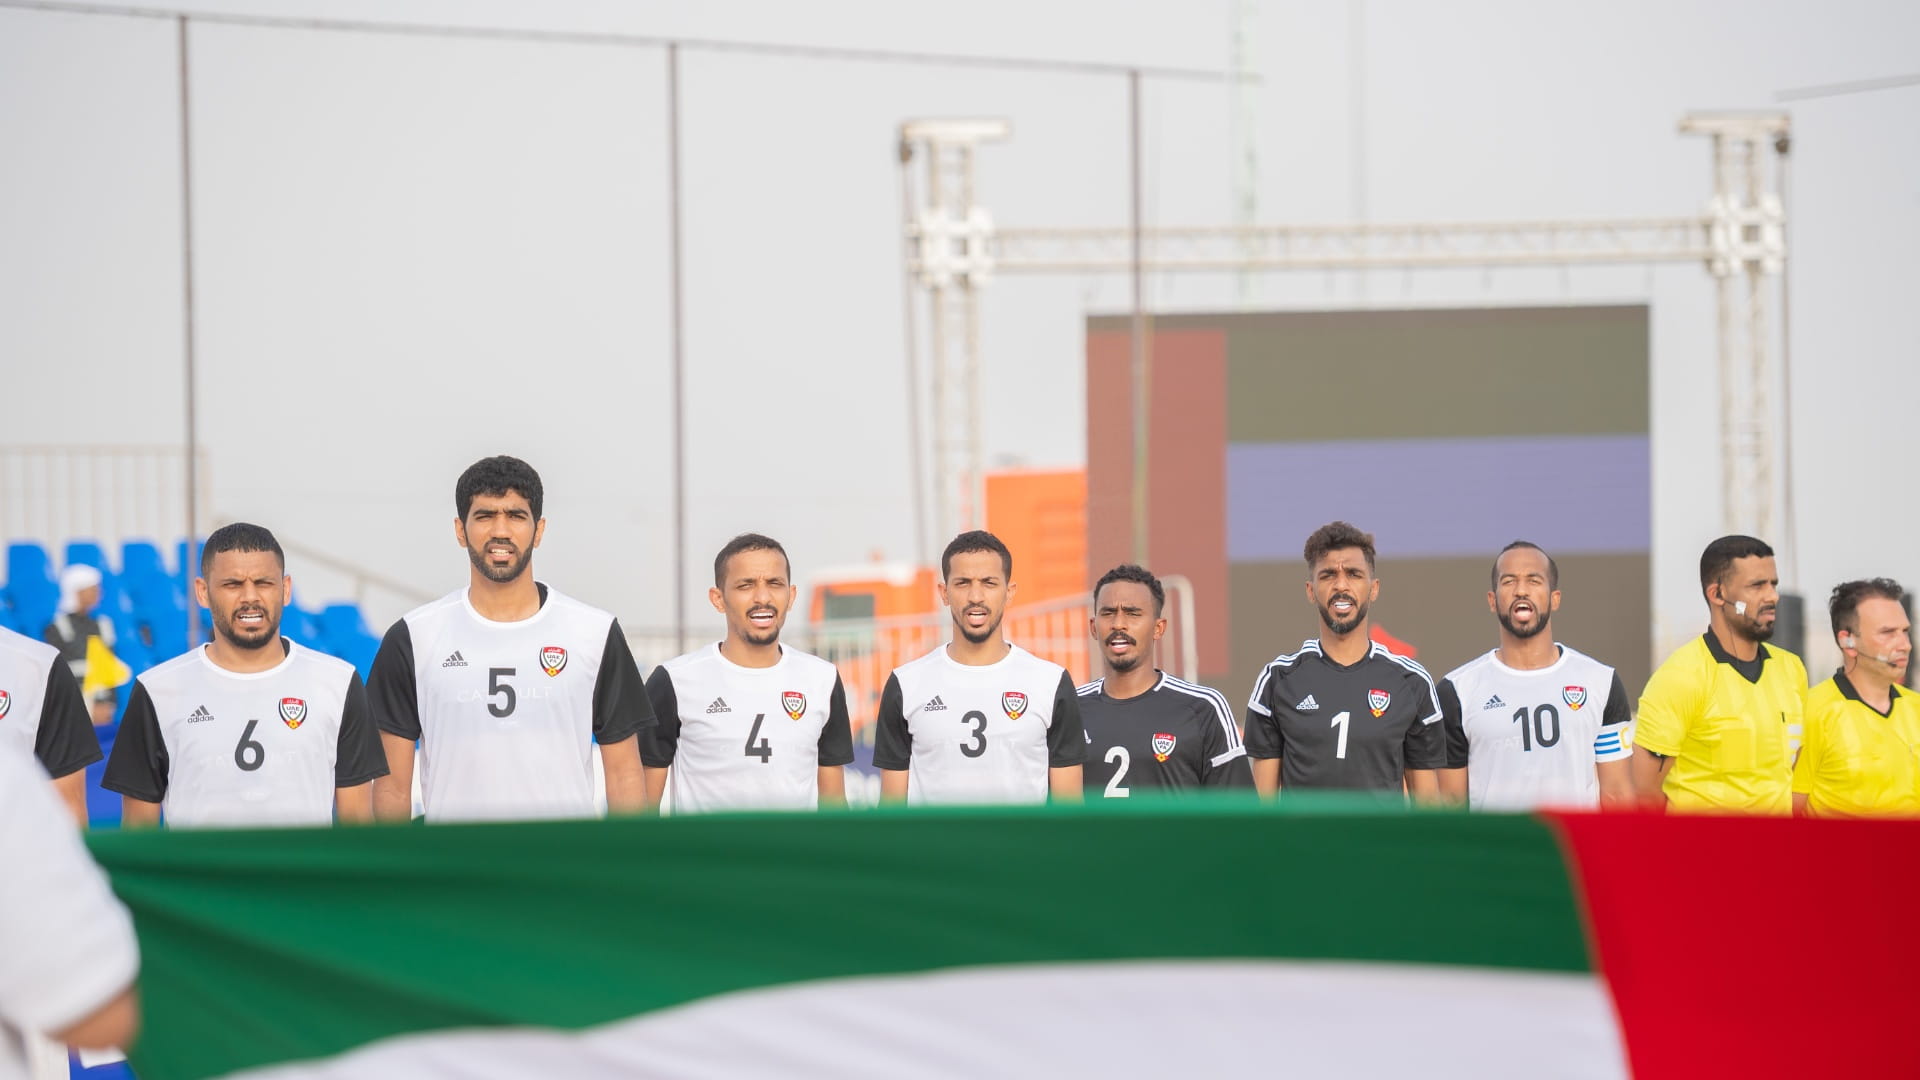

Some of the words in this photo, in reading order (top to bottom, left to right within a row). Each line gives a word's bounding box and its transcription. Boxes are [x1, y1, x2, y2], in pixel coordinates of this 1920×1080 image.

[442, 660, 468, 668] adidas
[488, 668, 516, 717] 5
[706, 706, 732, 714] adidas
[1483, 702, 1506, 710] adidas
[187, 715, 215, 724] adidas
[745, 714, 772, 763] 4
[960, 711, 986, 757] 3
[1331, 712, 1350, 758] 1
[1513, 704, 1560, 751] 10
[235, 720, 264, 771] 6
[1104, 746, 1129, 797] 2
